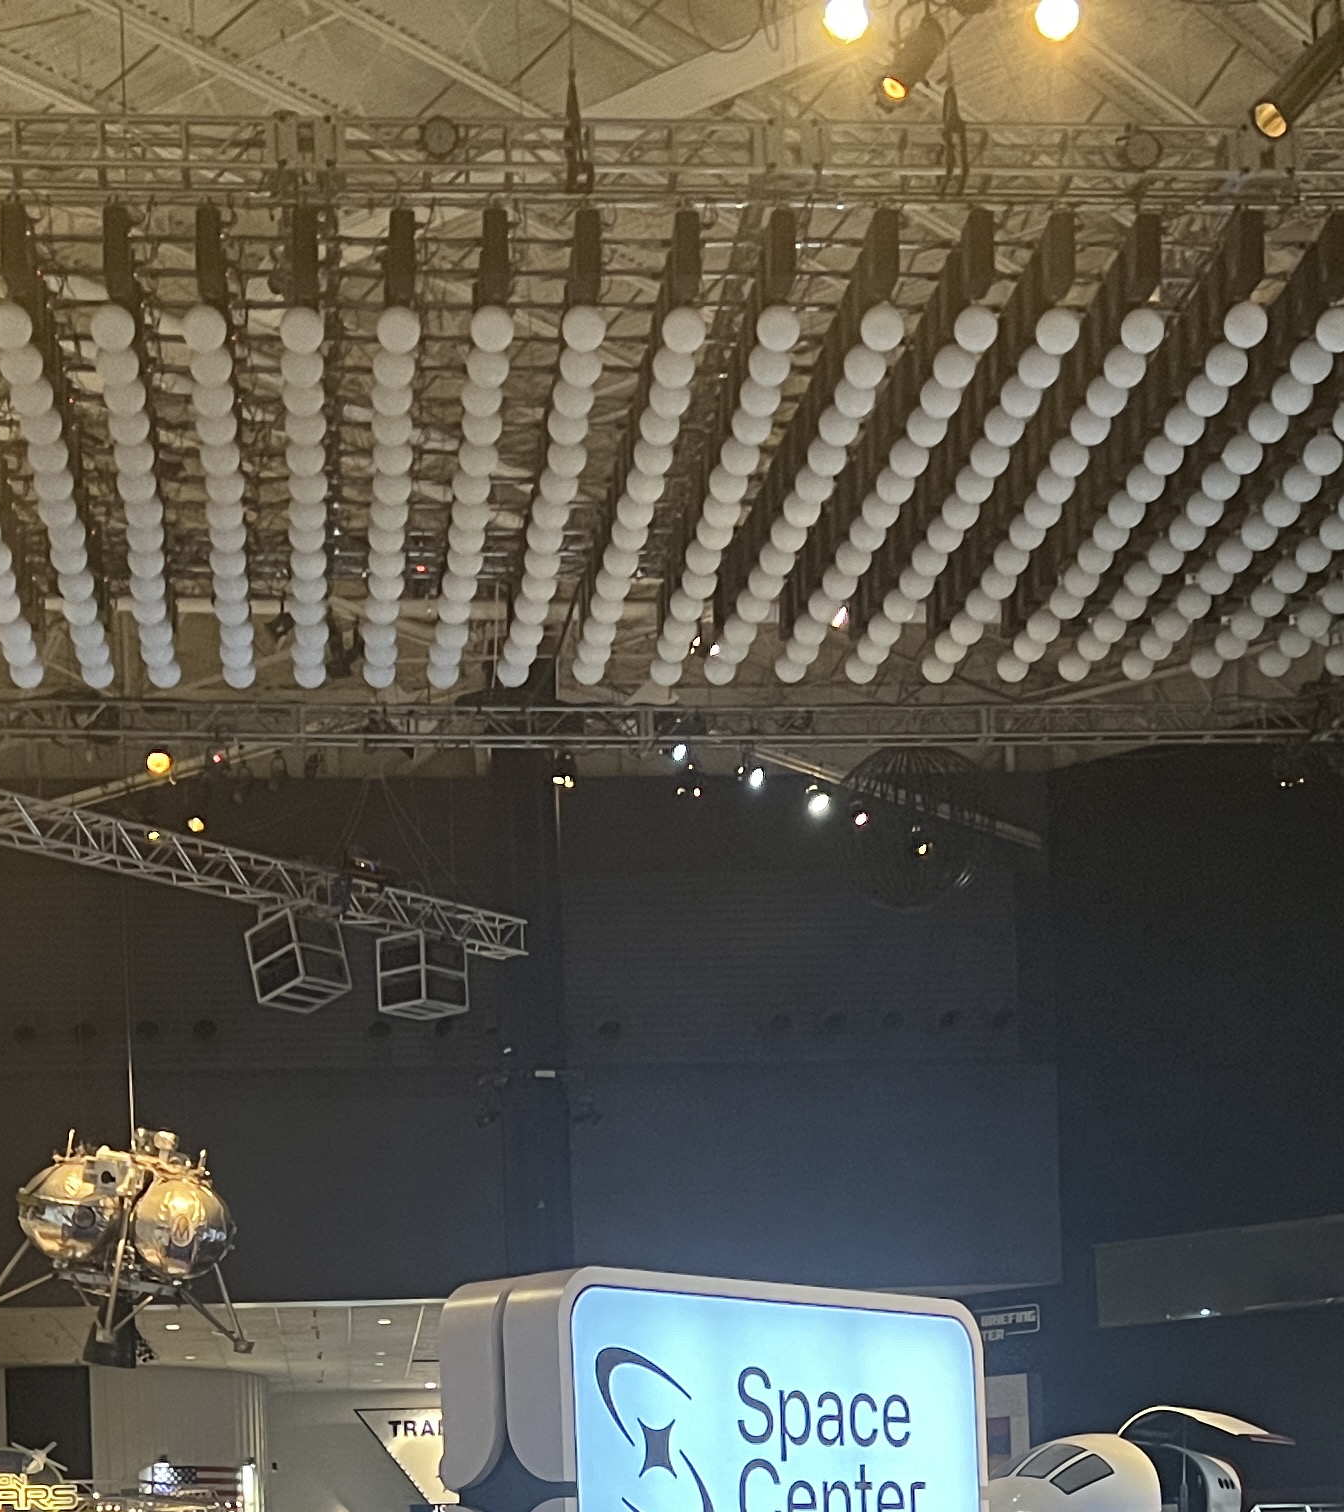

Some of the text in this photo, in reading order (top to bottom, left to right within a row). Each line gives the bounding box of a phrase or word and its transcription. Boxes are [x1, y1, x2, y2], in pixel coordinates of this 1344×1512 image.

[980, 1309, 1036, 1328] BRIEFING
[736, 1365, 912, 1462] Space
[387, 1419, 444, 1438] TRA
